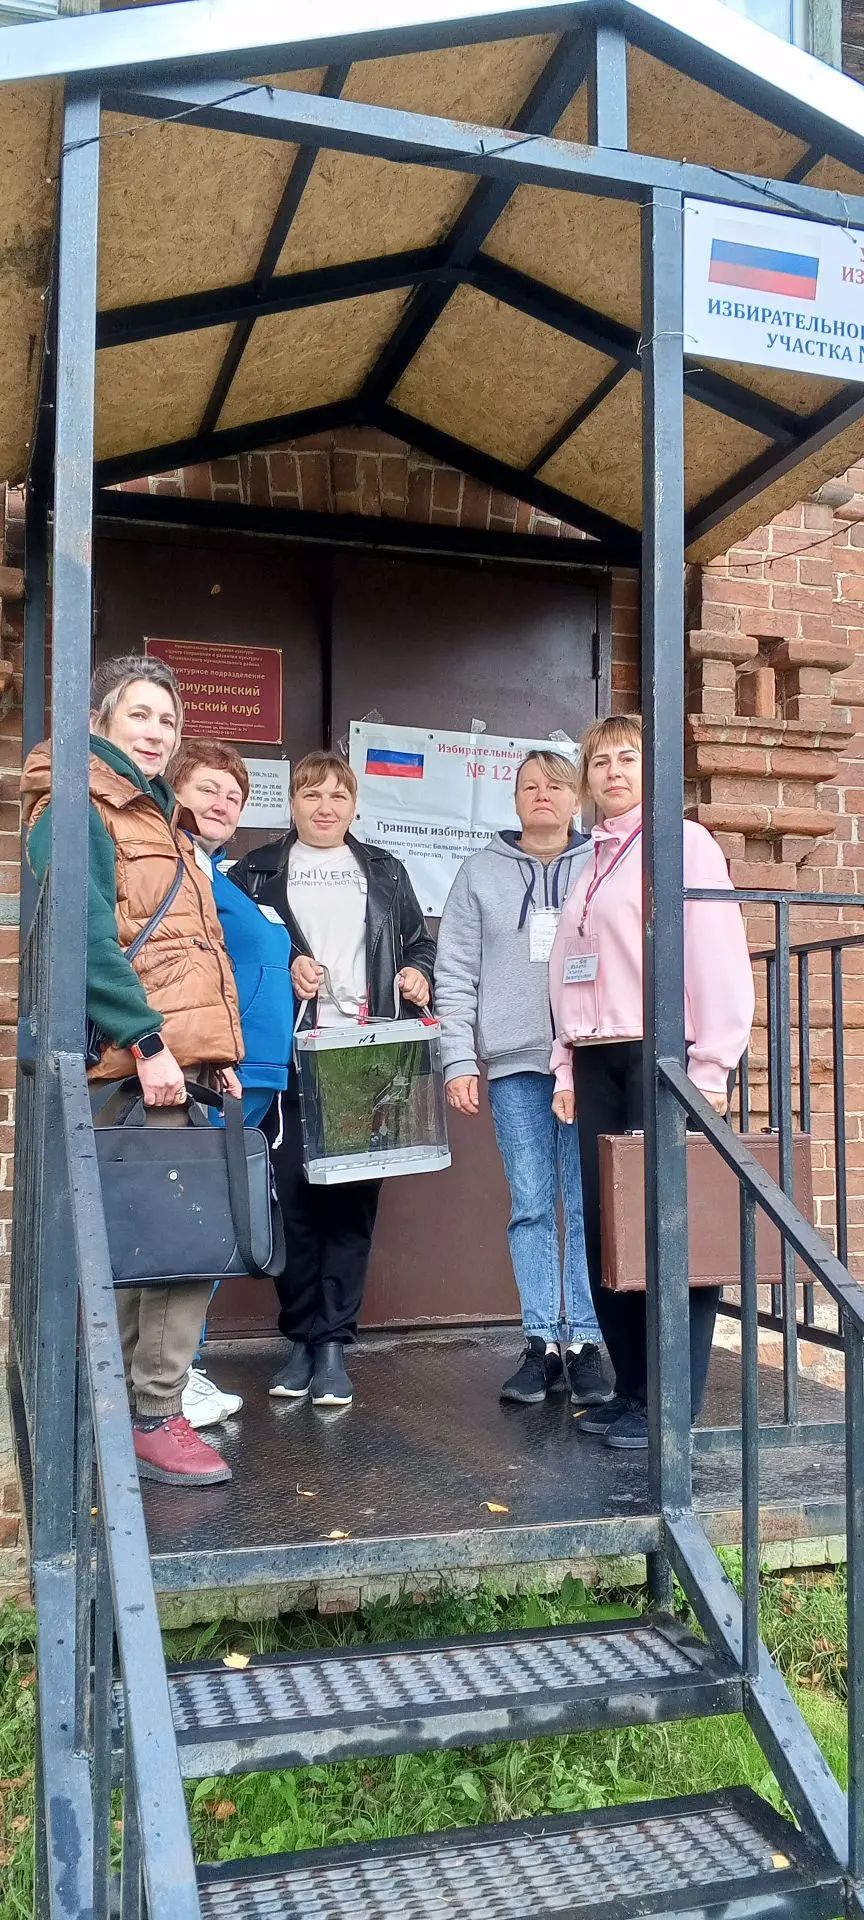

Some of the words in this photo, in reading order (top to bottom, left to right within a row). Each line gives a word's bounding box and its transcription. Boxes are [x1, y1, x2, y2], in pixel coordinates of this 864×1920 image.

[766, 333, 853, 362] УЧАСТКА
[210, 670, 266, 680] подразделение
[178, 682, 260, 697] риухринский
[231, 704, 261, 717] клуб
[438, 743, 523, 760] Избирательный
[466, 762, 486, 778] №
[491, 765, 514, 781] 12
[376, 821, 428, 836] Границы
[288, 880, 323, 888] INFINITY
